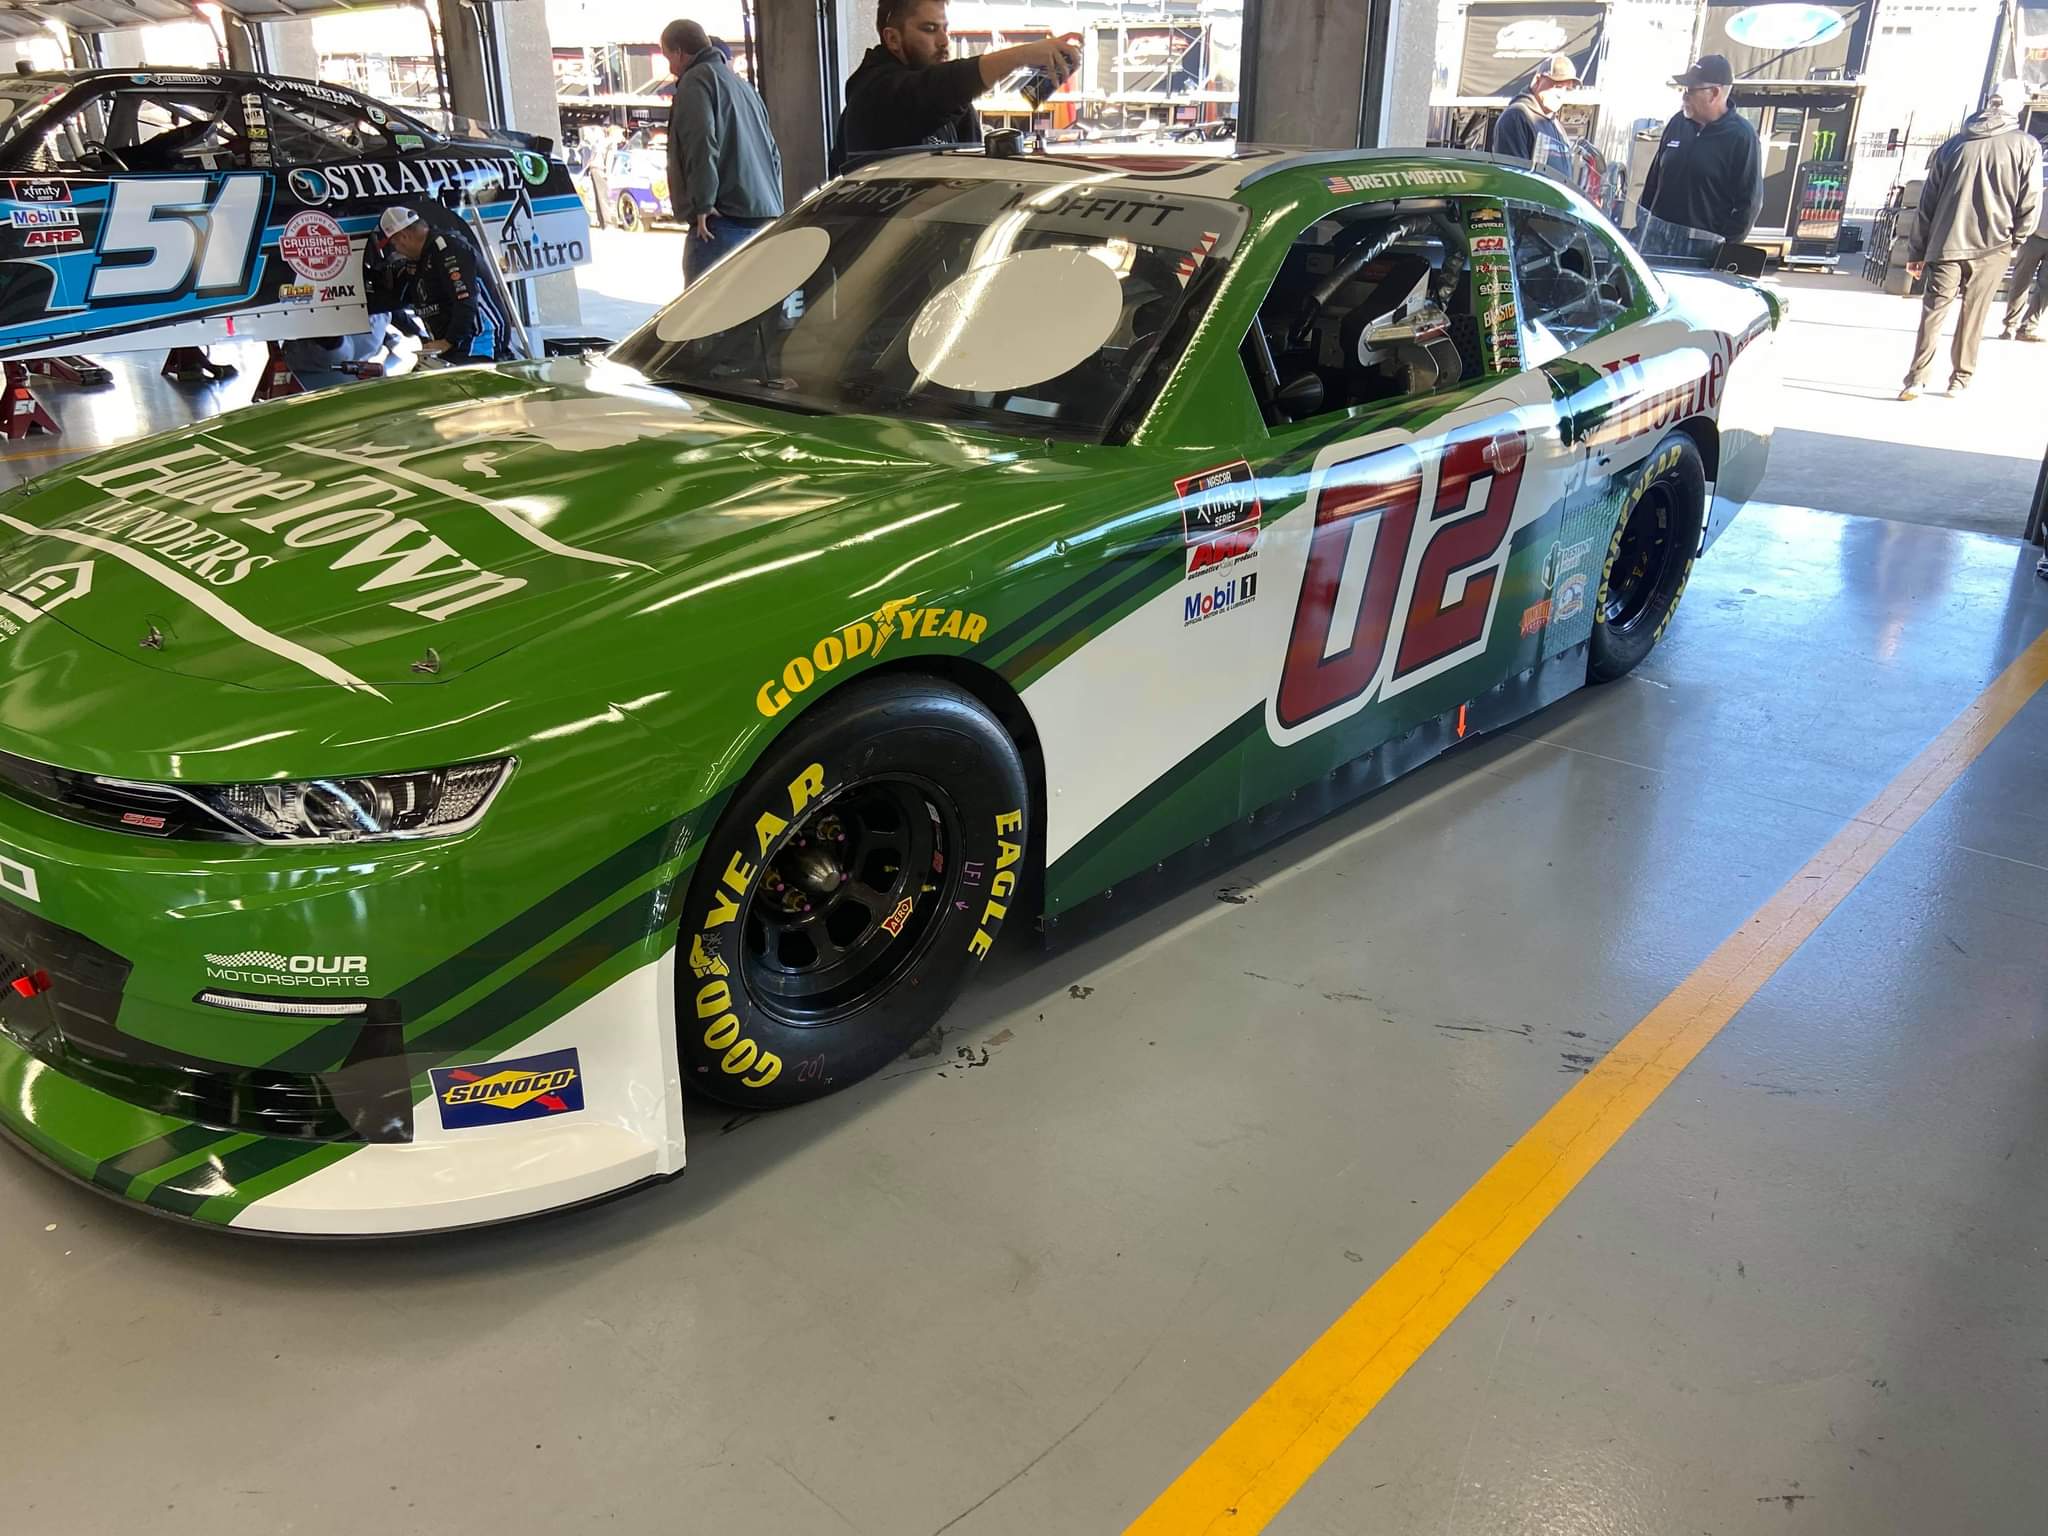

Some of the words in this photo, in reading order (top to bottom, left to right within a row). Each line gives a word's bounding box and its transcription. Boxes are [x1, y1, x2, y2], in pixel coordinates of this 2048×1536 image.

[323, 157, 525, 201] STRAITLINE
[1348, 172, 1401, 191] BRETT
[1400, 169, 1467, 186] MOFFITT
[22, 185, 60, 199] xfinity
[13, 210, 57, 225] Mobil
[27, 231, 81, 244] ARP
[88, 173, 265, 302] 51
[283, 237, 335, 249] CRUISING
[297, 245, 349, 257] KITCHENS
[504, 240, 584, 273] Nitro
[1206, 471, 1232, 488] NASCAR
[1197, 487, 1246, 524] xfinity
[1214, 511, 1236, 527] SERIES
[77, 499, 279, 586] LENDERS
[1188, 527, 1259, 573] ARP
[1274, 426, 1528, 731] 02
[1184, 579, 1236, 621] Mobil
[120, 812, 166, 829] SS
[968, 808, 1023, 962] EAGLE
[890, 902, 910, 931] AERO
[206, 966, 370, 987] MOTORSPORTS
[289, 955, 367, 974] OUR
[450, 1070, 570, 1102] SUNOCO
